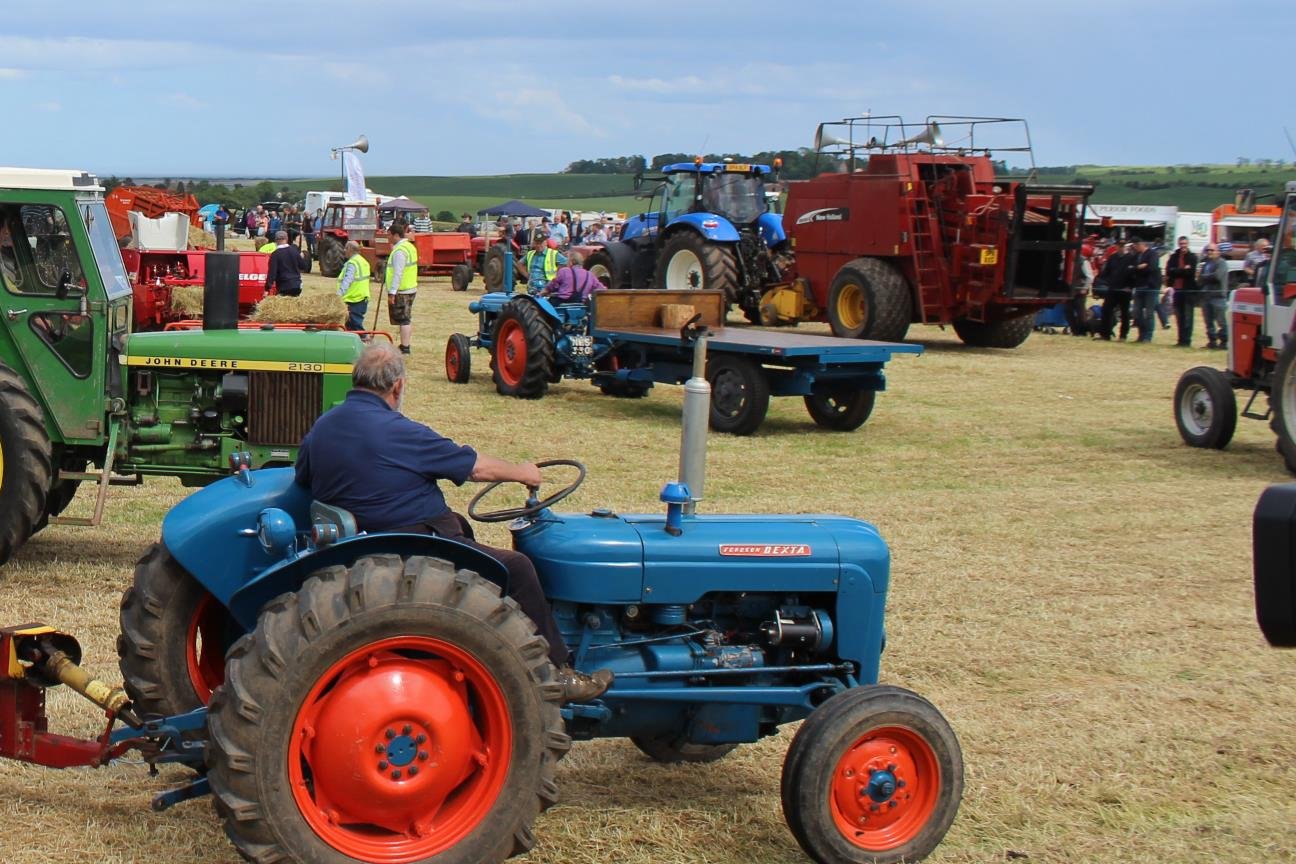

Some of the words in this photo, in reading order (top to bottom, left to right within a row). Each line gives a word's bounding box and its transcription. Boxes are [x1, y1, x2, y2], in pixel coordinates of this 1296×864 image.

[145, 357, 181, 366] JOHN
[190, 359, 238, 368] DEERE
[288, 362, 322, 372] 2130
[763, 546, 805, 555] DEXTA
